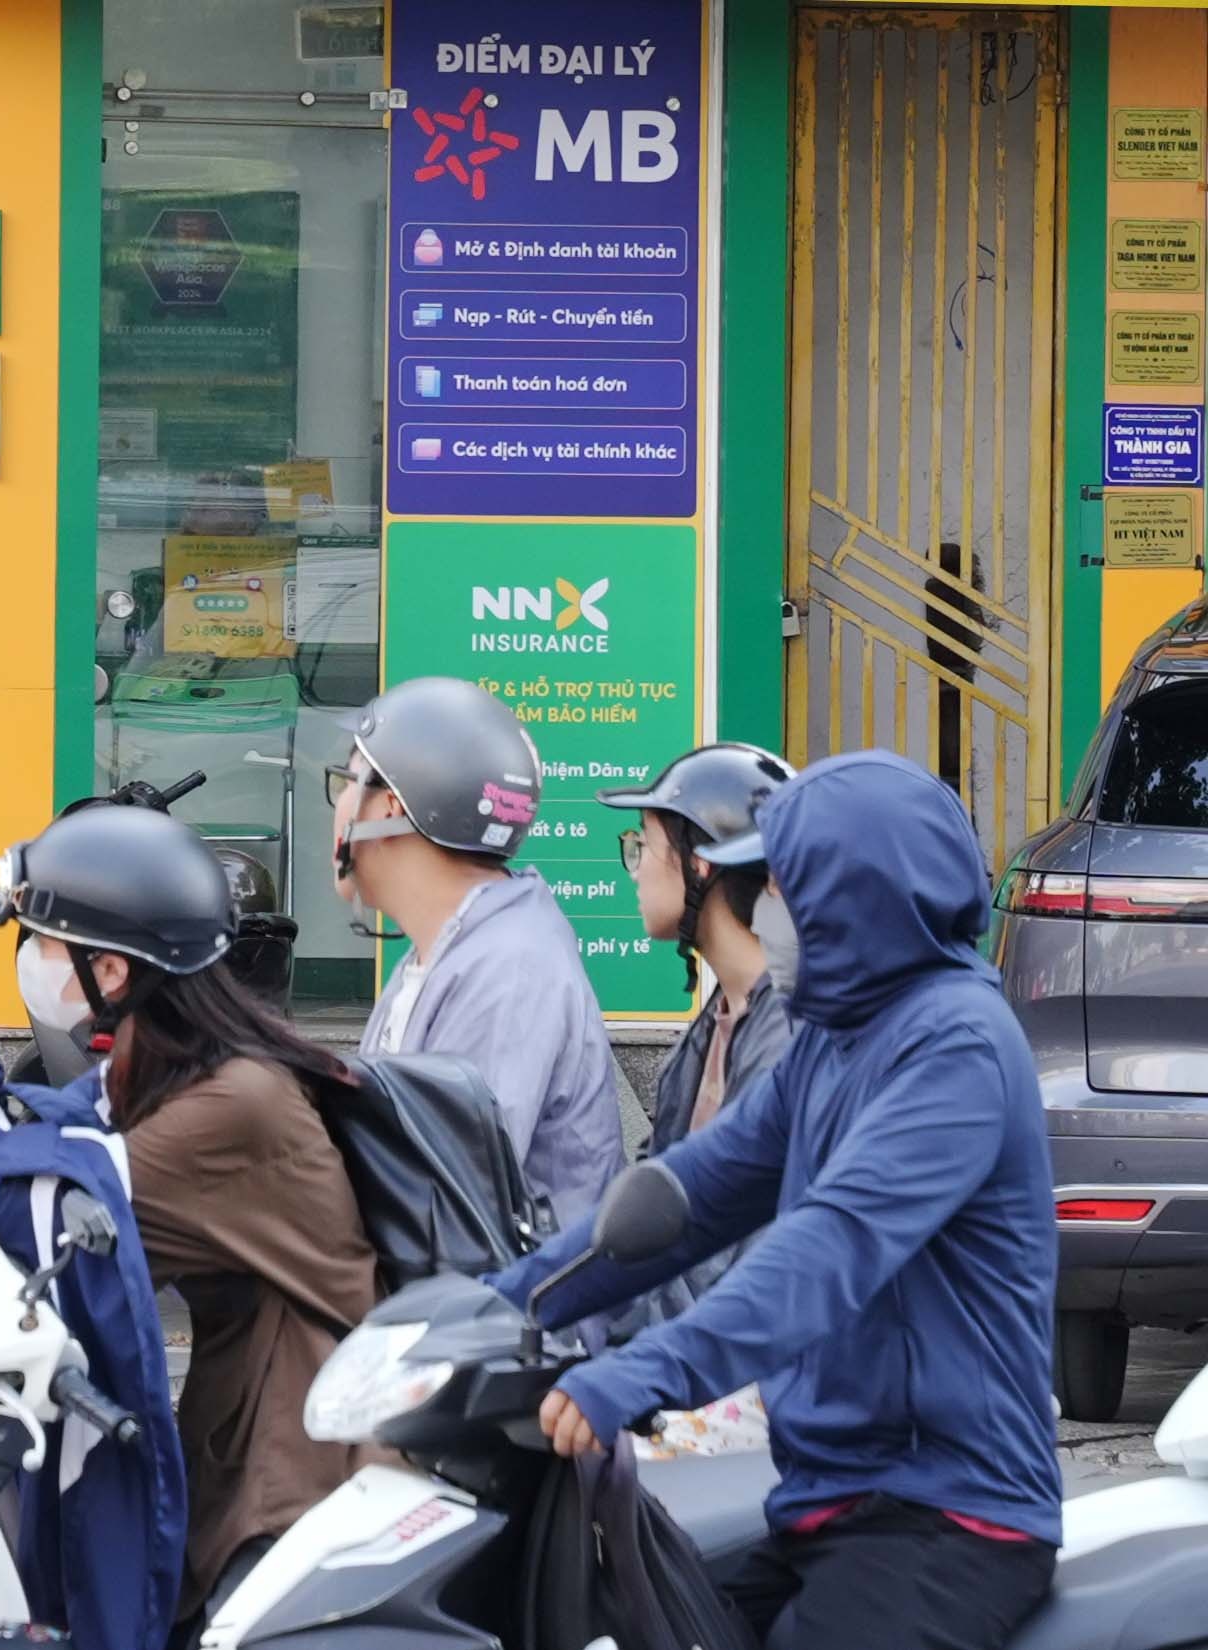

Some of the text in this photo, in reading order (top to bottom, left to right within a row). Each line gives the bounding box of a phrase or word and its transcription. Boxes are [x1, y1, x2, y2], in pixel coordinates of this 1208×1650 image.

[437, 33, 656, 84] ĐIỂM ĐẠI LÝ
[535, 108, 679, 182] MB
[1178, 141, 1198, 152] NAM
[455, 240, 677, 262] Mở & Định danh tài khoản
[1178, 253, 1196, 263] NAM
[453, 308, 491, 328] Nạp
[506, 308, 536, 325] Rút
[552, 306, 617, 329] Chuyển
[621, 308, 654, 326] tiền
[453, 374, 628, 392] Thanh toán hoá đơn
[1135, 427, 1145, 435] TY
[453, 441, 677, 462] Các dịch vụ tài chính khác
[1114, 437, 1192, 455] THÀNH GIA
[1132, 527, 1156, 542] VIỆT
[1159, 529, 1185, 539] NAM
[471, 634, 609, 653] INSURANCE
[477, 675, 676, 702] ẤP & HỖ TRỢ THỦ TỤC
[548, 703, 586, 723] BẢO
[591, 702, 637, 723] HIỂM
[541, 761, 649, 781] hiệm Dân sự
[554, 822, 566, 837] ô
[569, 822, 588, 837] tô
[548, 880, 616, 899] viện phí
[587, 936, 652, 957] phí y tế
